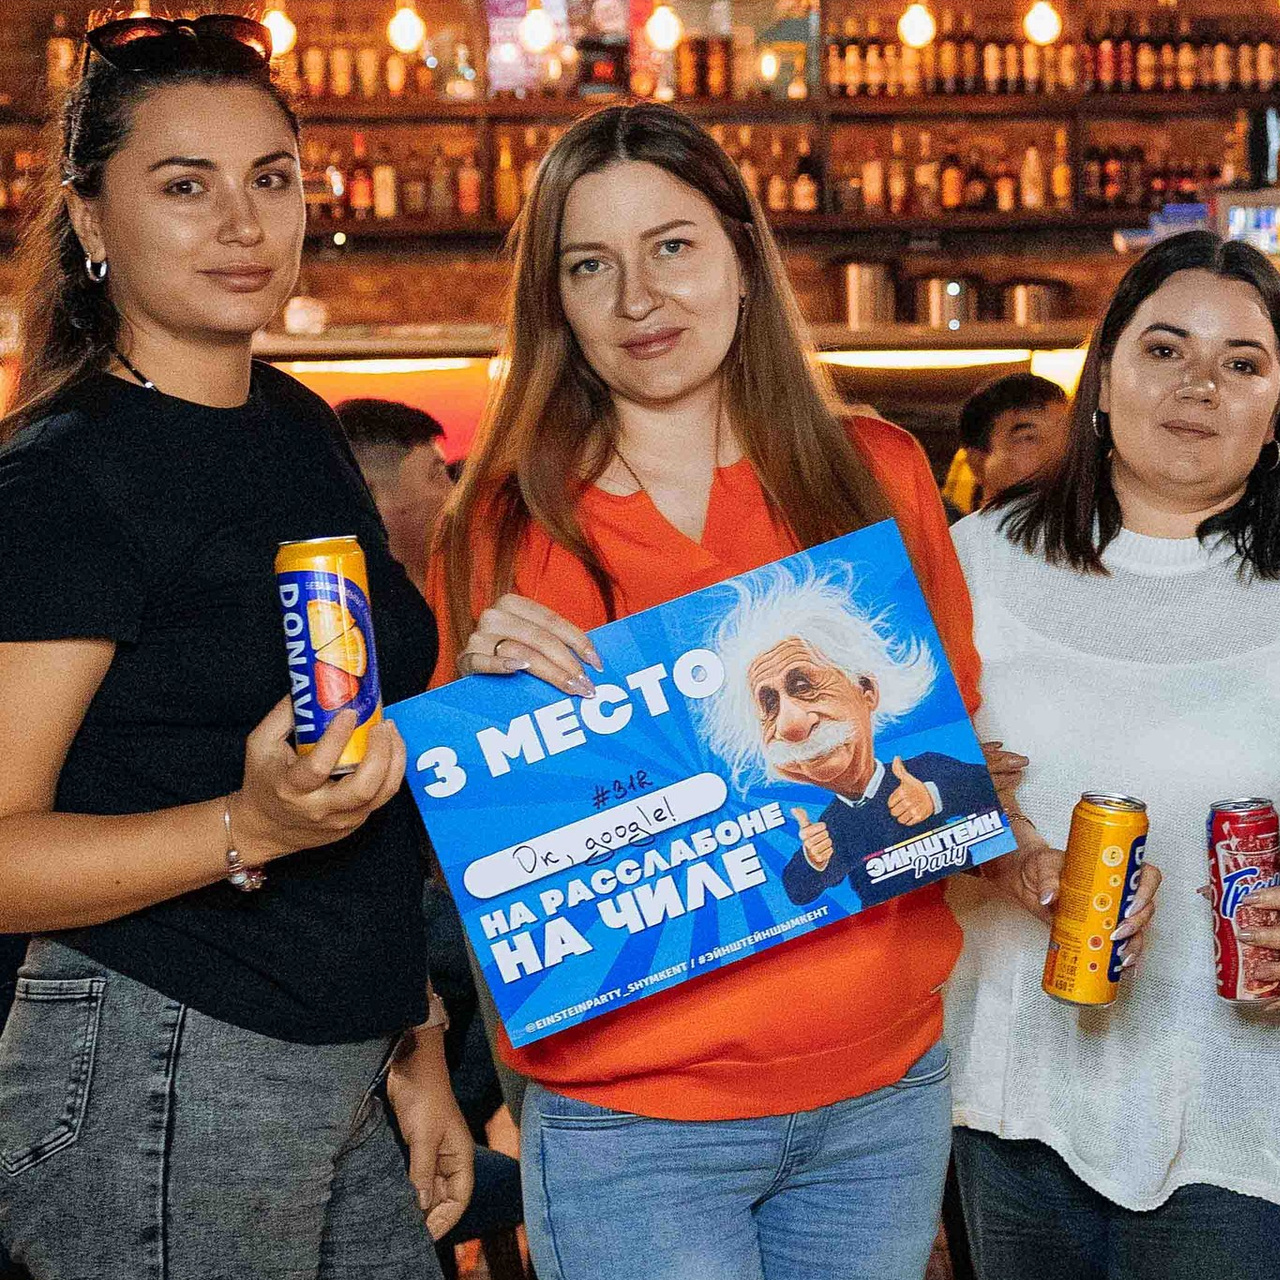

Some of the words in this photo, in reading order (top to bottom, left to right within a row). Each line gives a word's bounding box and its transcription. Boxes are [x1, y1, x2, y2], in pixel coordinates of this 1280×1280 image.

[278, 583, 315, 733] DONAVI
[416, 746, 467, 799] 3
[476, 648, 725, 778] МЕСТО
[479, 901, 538, 940] НА
[539, 802, 786, 916] РАССЛАБОНЕ
[585, 796, 677, 866] google!
[913, 844, 968, 879] Party
[490, 916, 593, 985] НА
[597, 843, 767, 935] ЧИЛЕ
[524, 961, 689, 1034] @EINSTEINPARTY_SHYMKENT
